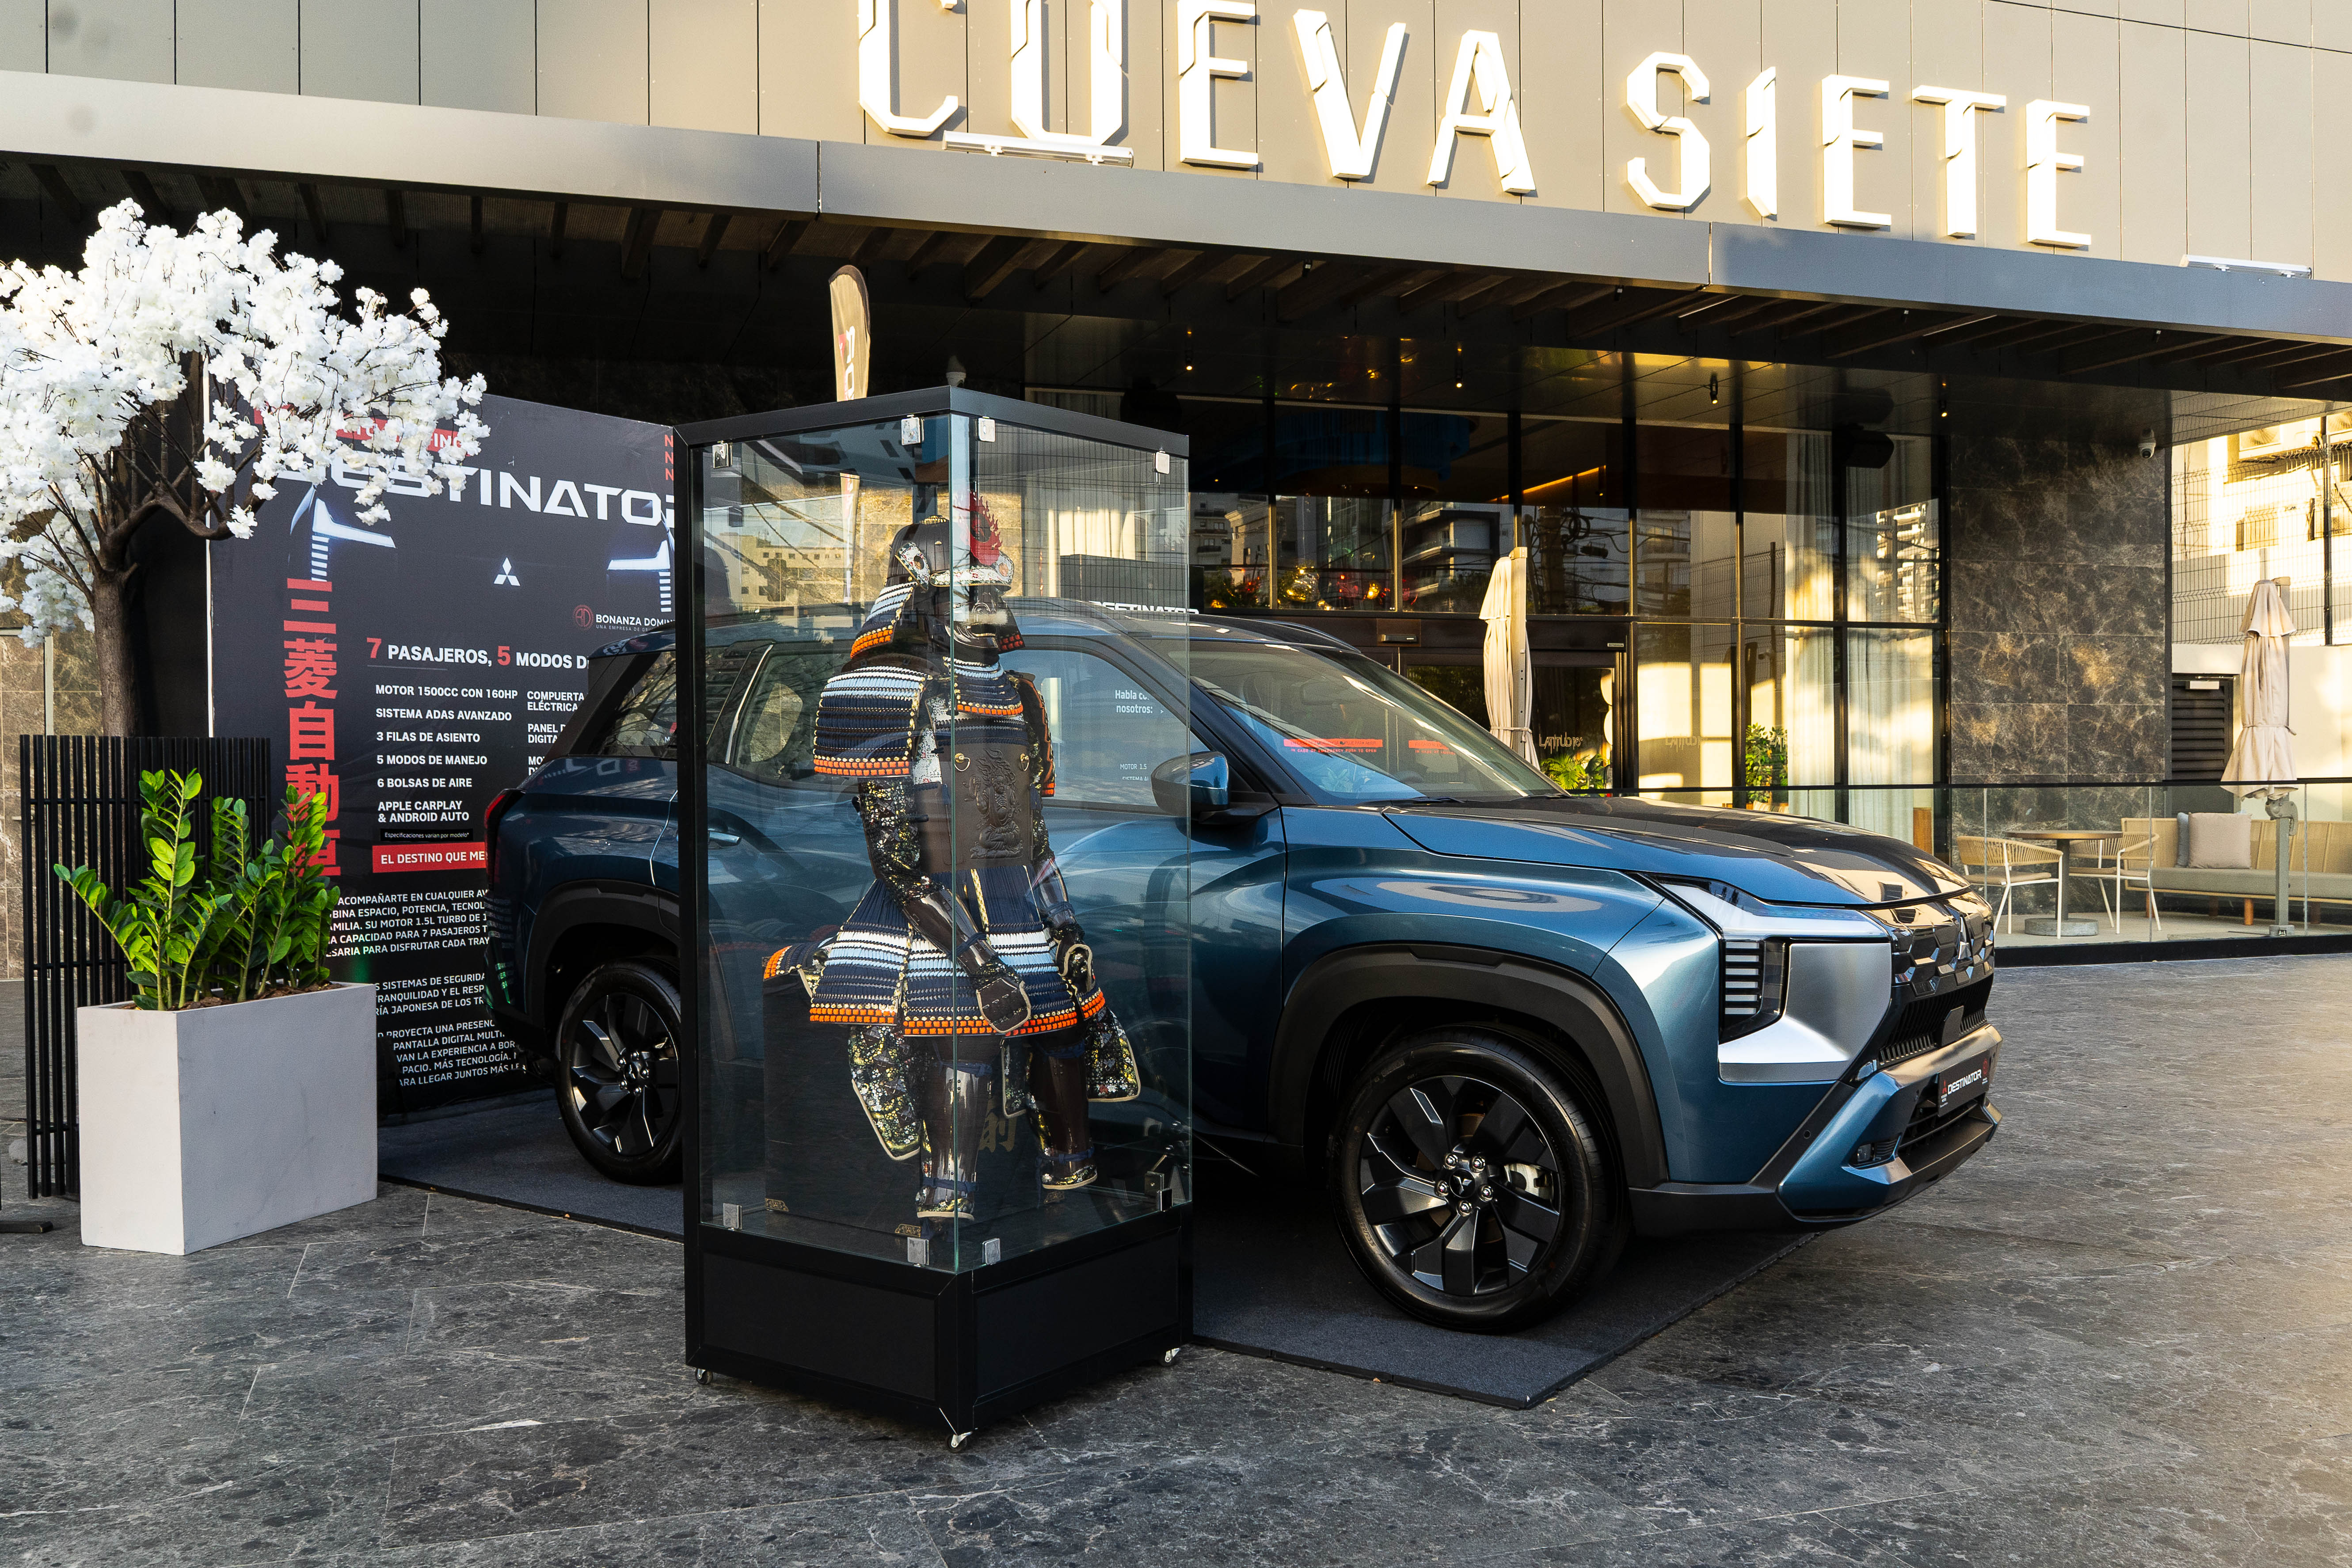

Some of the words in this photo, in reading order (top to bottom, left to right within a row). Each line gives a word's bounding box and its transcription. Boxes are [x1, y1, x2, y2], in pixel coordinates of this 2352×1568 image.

[858, 0, 1537, 194] CUEVA
[1626, 51, 2092, 246] SIETE
[596, 614, 642, 626] BONANZA
[366, 637, 382, 659] 7
[388, 644, 492, 667] PASAJEROS,
[497, 645, 511, 666] 5
[516, 652, 573, 669] MODOS
[376, 685, 415, 696] MOTOR
[418, 686, 459, 697] 1500CC
[461, 688, 483, 698] CON
[486, 689, 518, 700] 160HP
[527, 690, 585, 701] COMPUERTA
[1115, 689, 1137, 700] Habla
[527, 700, 578, 712] ELÉCTRICA
[1116, 704, 1153, 714] nosotros:
[376, 708, 422, 719] SISTEMA
[425, 710, 455, 720] ADAS
[457, 711, 512, 721] AVANZADO
[528, 723, 559, 733] PANEL
[376, 732, 384, 741] 3
[386, 732, 416, 742] FILAS
[419, 732, 433, 742] DE
[436, 733, 481, 742] ASIENTO
[377, 755, 384, 765] 5
[386, 755, 426, 765] MODOS
[429, 755, 442, 765] DE
[445, 755, 487, 765] MANEJO
[377, 778, 384, 788] 6
[387, 778, 429, 788] BOLSAS
[432, 778, 446, 788] DE
[448, 778, 472, 788] AIRE
[377, 801, 412, 811] APPLE
[414, 800, 463, 811] CARPLAY
[377, 812, 387, 823] &
[389, 812, 438, 823] ANDROID
[440, 811, 469, 822] AUTO
[381, 854, 394, 864] EL
[397, 852, 443, 864] DESTINO
[445, 852, 467, 864] QUE
[337, 893, 408, 906] ACOMPAÑARTE
[411, 893, 423, 902] EN
[425, 890, 475, 901] CUALQUIER
[330, 909, 356, 919] BINA
[358, 907, 400, 918] ESPACIO,
[402, 904, 449, 915] POTENCIA,
[365, 921, 377, 929] SU
[380, 918, 413, 929] MOTOR
[415, 917, 435, 926] 1.5L
[437, 914, 467, 925] TURBO
[468, 913, 481, 922] DE
[340, 932, 393, 944] CAPACIDAD
[395, 930, 420, 940] PARA
[422, 929, 427, 938] 7
[430, 926, 481, 936] PASAJEROS
[363, 945, 388, 955] PARA
[390, 941, 440, 953] DISFRUTAR
[442, 939, 467, 948] CADA
[382, 978, 427, 990] SISTEMAS
[430, 977, 442, 986] DE
[441, 988, 448, 997] Y
[450, 987, 461, 996] EL
[463, 985, 485, 994] RESP
[391, 1001, 439, 1014] JAPONESA
[441, 999, 453, 1009] DE
[455, 998, 472, 1007] LOS
[435, 1024, 454, 1033] UNA
[393, 1038, 439, 1050] PANTALLA
[441, 1034, 475, 1045] DIGITAL
[417, 1051, 429, 1060] LA
[431, 1044, 488, 1058] EXPERIENCIA
[434, 1059, 454, 1070] MÁS
[456, 1051, 512, 1066] TECNOLOGÍA.
[419, 1072, 453, 1085] LLEGAR
[454, 1067, 488, 1079] JUNTOS
[490, 1063, 510, 1074] MÁS
[1948, 1069, 1982, 1095] DESTINATOR
